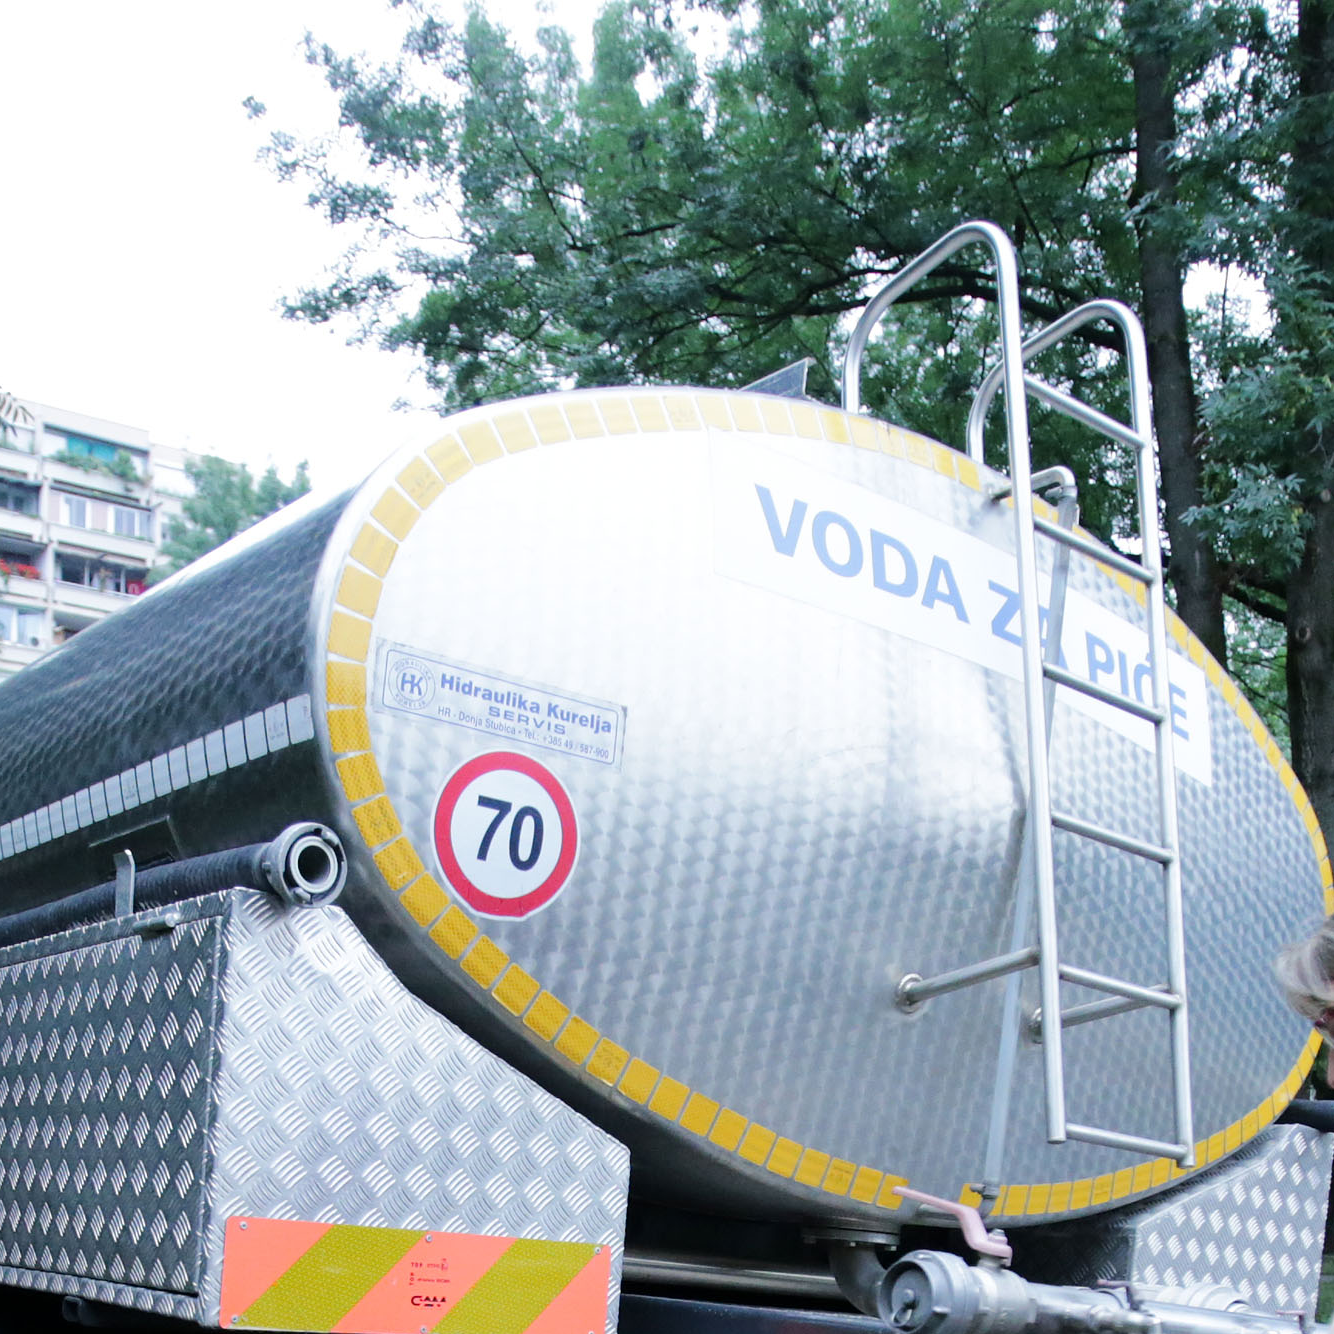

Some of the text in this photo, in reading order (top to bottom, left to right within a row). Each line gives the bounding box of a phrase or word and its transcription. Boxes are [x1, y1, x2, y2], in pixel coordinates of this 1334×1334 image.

[754, 483, 971, 625] VODA
[401, 672, 423, 696] HK
[440, 672, 612, 734] Hidraulika Kurelja
[437, 706, 451, 718] HR
[458, 711, 483, 728] Donja
[485, 718, 516, 735] Stubica
[488, 705, 566, 735] SERVIS
[476, 795, 544, 871] 70
